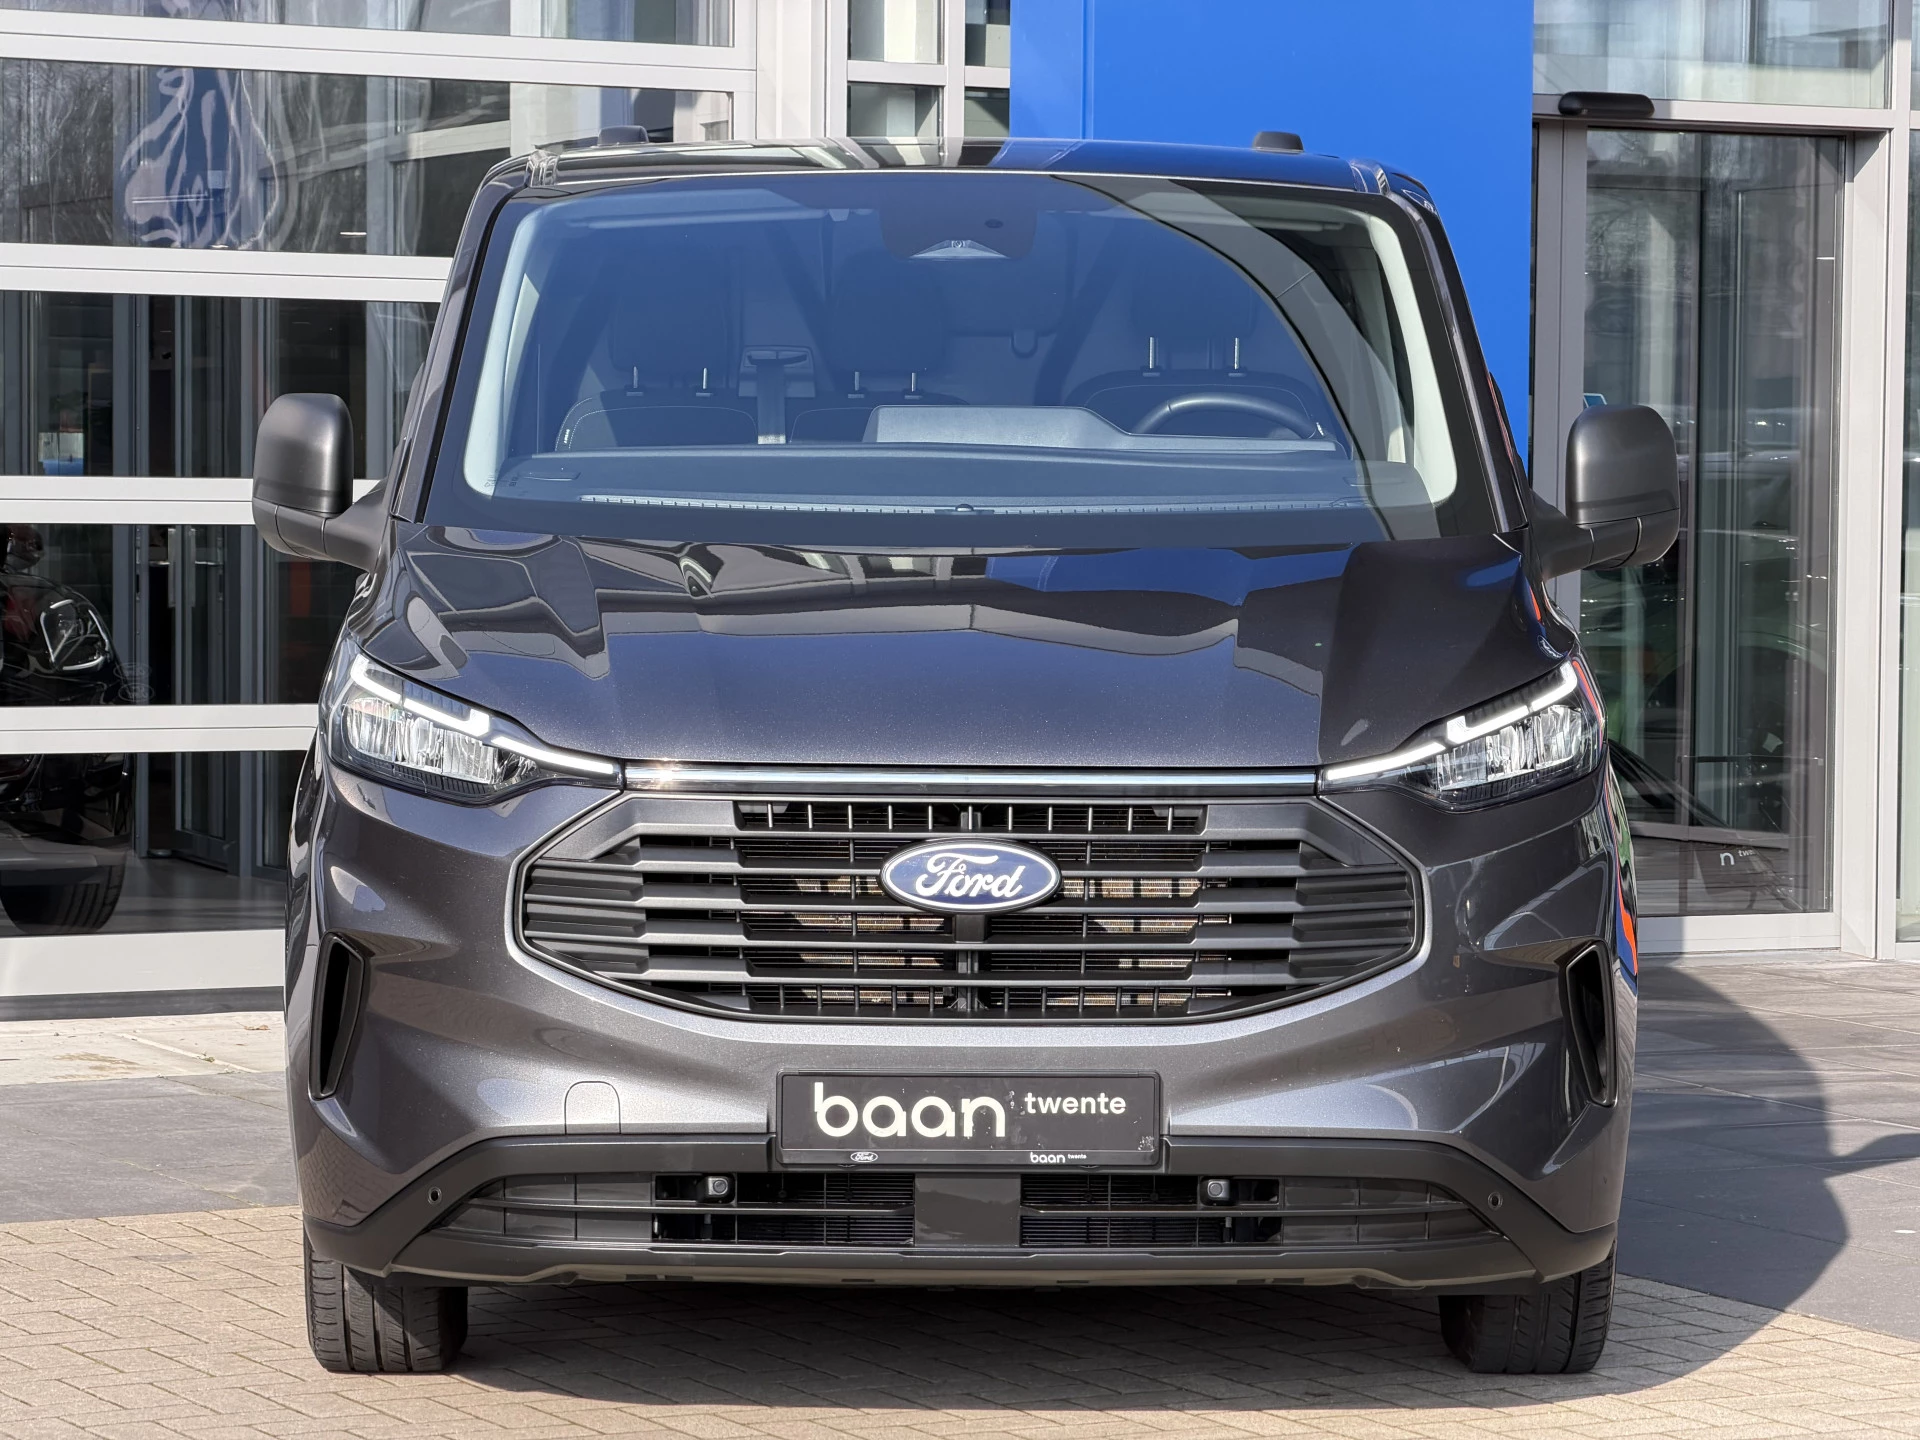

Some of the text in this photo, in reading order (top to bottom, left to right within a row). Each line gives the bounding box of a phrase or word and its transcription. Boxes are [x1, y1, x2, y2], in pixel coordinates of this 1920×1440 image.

[915, 852, 1026, 898] Ford
[814, 1081, 1126, 1138] baan twente
[1030, 1151, 1066, 1164] baan
